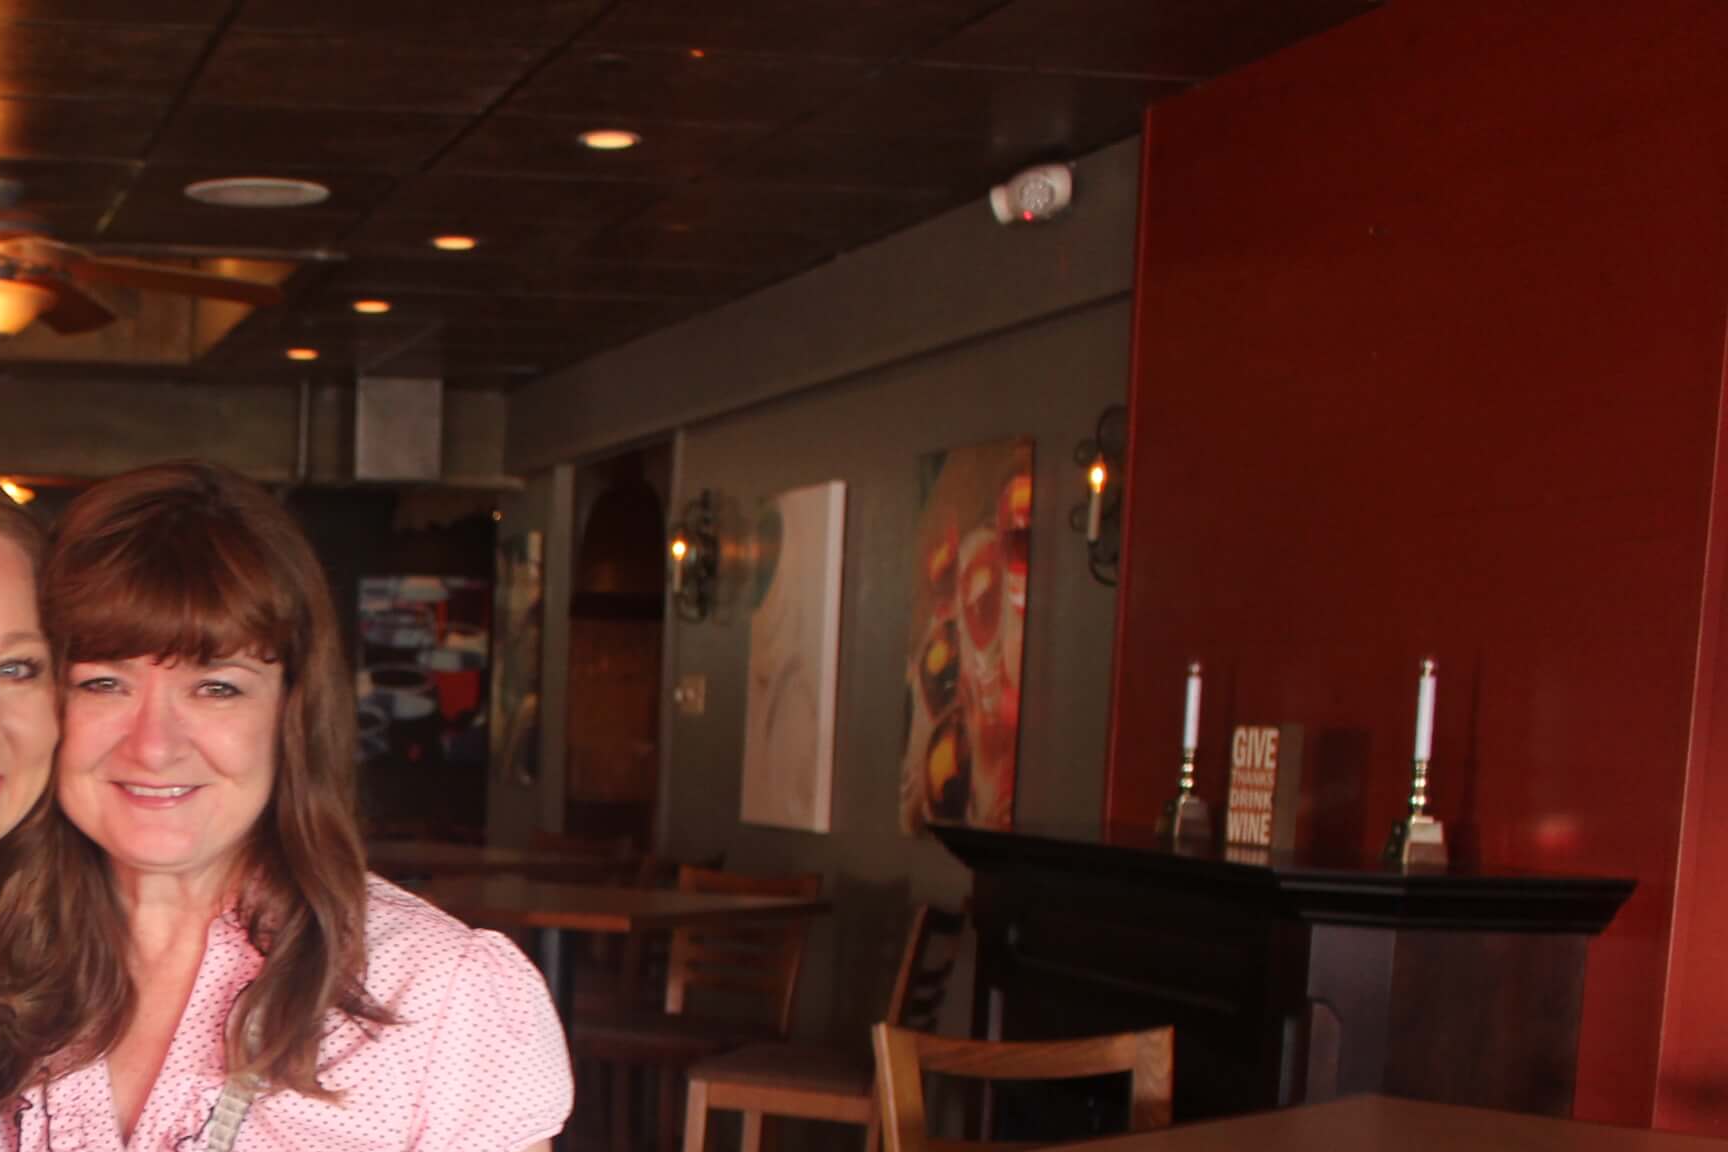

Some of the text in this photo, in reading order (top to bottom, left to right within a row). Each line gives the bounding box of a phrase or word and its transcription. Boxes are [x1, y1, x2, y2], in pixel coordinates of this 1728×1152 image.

[1232, 727, 1278, 768] GIVE
[1229, 788, 1272, 809] DRINK
[1226, 811, 1271, 844] WINE
